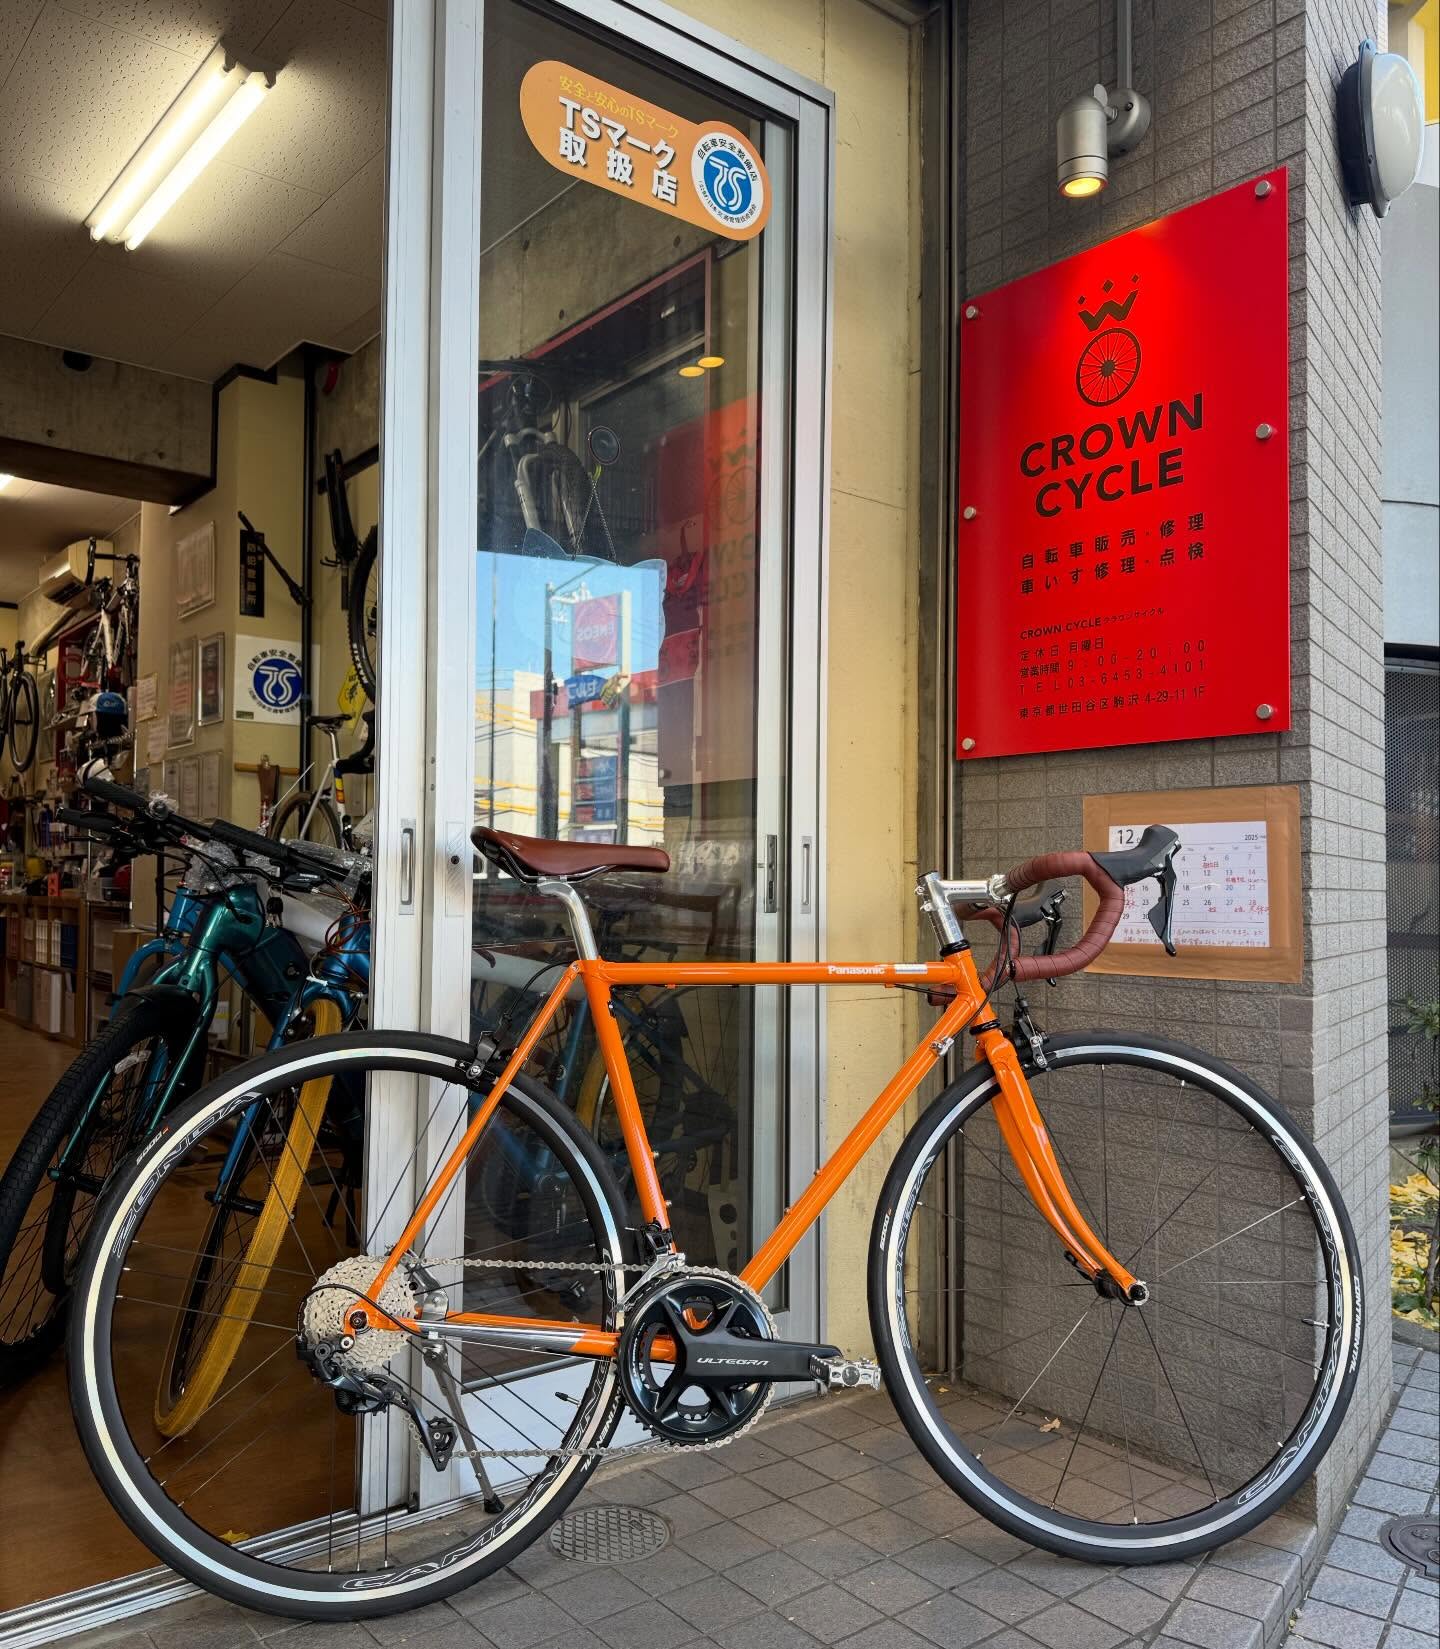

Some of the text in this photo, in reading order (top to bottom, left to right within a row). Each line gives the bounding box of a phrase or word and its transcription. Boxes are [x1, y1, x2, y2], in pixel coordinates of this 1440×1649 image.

[559, 75, 679, 138] 安全と安心のTSマーク
[559, 96, 676, 169] TSマーク
[559, 126, 679, 206] 取扱店
[1019, 392, 1204, 478] CROWN
[1035, 447, 1184, 518] CYCLE
[1021, 512, 1204, 570] 自転車販売・修理
[1021, 541, 1204, 595] 車いす修理・点検
[1019, 624, 1062, 641] CROWN
[1065, 616, 1102, 633] CYCLE
[1019, 644, 1060, 662] 定休日
[1019, 661, 1060, 680] 営業時間
[1018, 694, 1139, 720] 東京都世田谷区駒沢
[1117, 829, 1134, 844] 12
[1122, 912, 1130, 920] 29
[828, 965, 886, 975] Panasonic
[1348, 1274, 1362, 1375] CONTINENTAL
[696, 1357, 770, 1367] ULTEGRA
